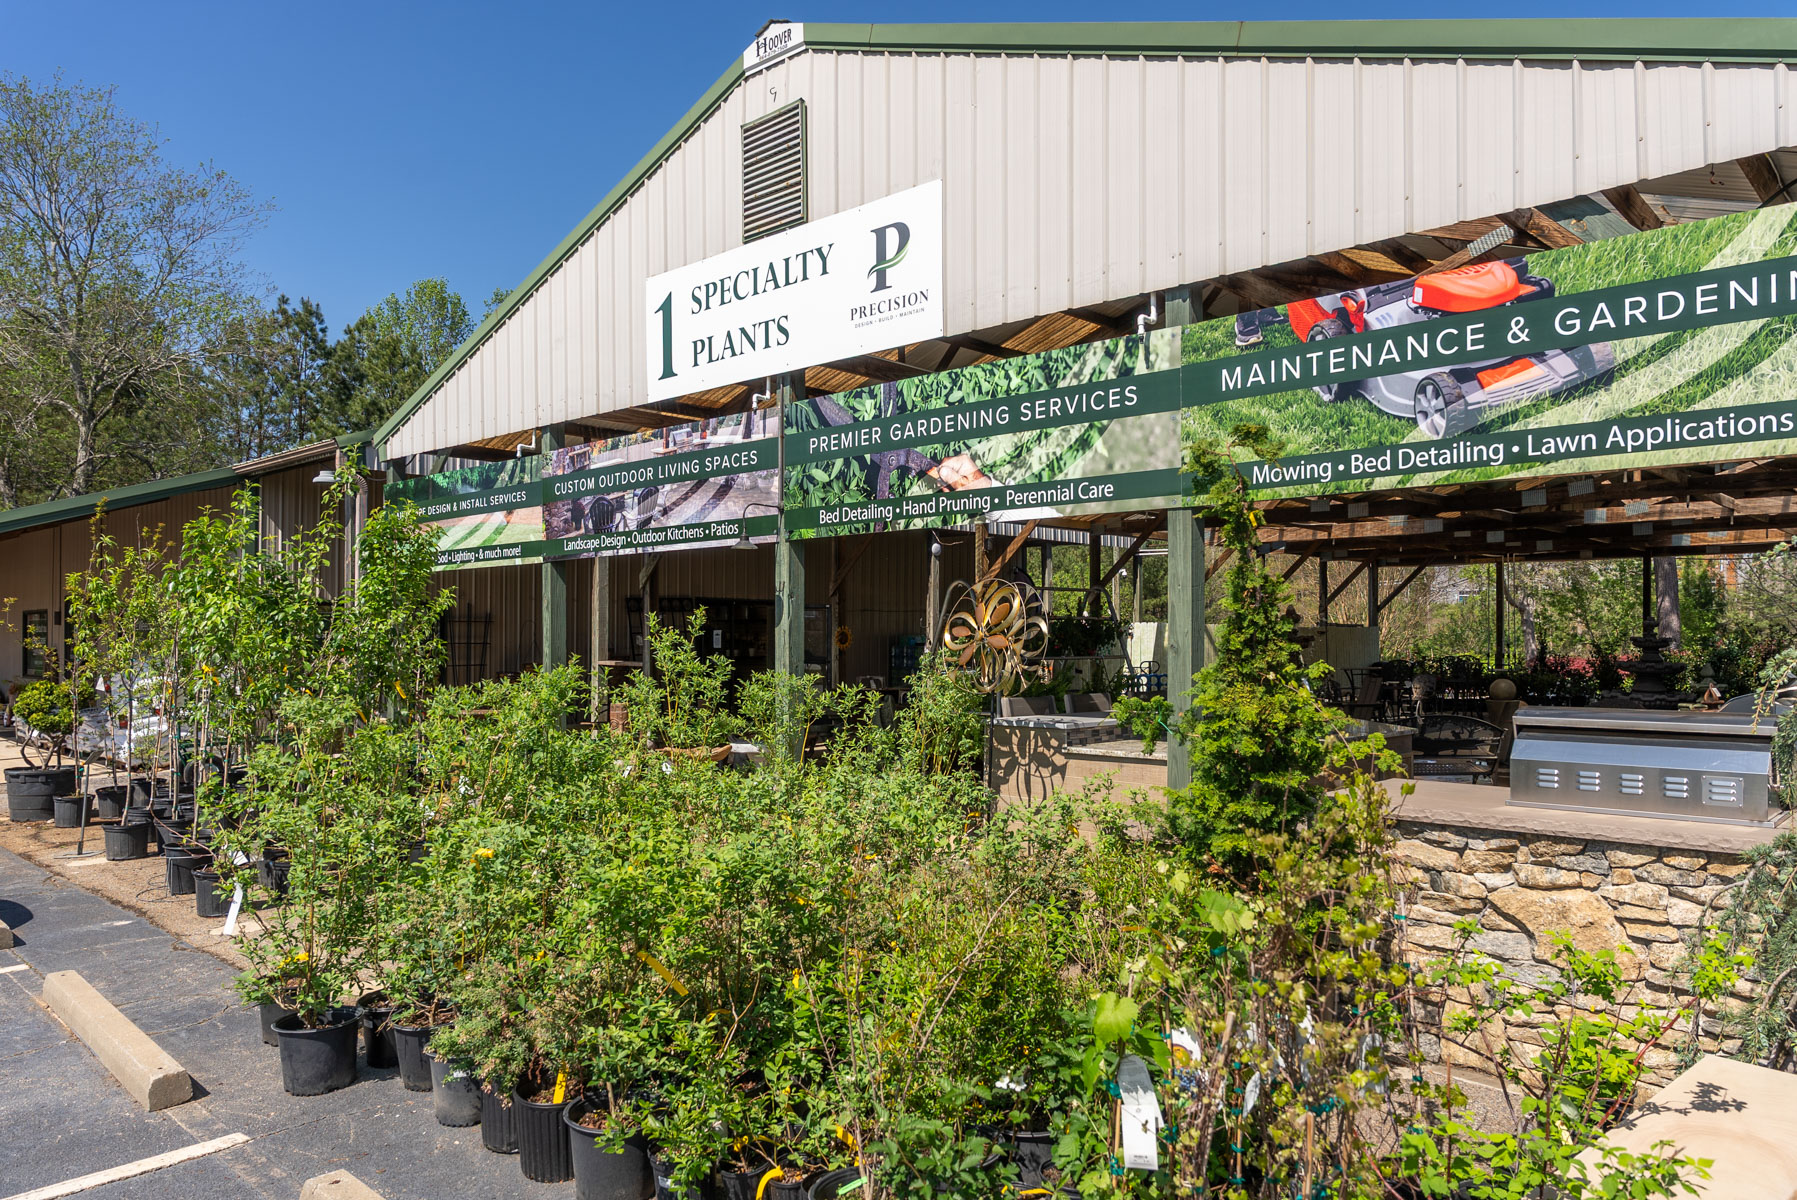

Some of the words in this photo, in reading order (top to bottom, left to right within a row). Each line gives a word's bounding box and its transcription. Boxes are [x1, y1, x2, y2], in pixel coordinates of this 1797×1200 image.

[756, 28, 792, 57] HOOVER
[691, 243, 834, 314] SPECIALTY
[850, 289, 929, 321] PRECISION
[855, 320, 873, 329] DESIGN
[878, 314, 894, 323] BUILD
[899, 307, 925, 318] MAINTAIN
[655, 291, 679, 380] 1
[691, 315, 789, 367] PLANTS
[1221, 321, 1485, 391] MAINTENANCE
[1507, 316, 1530, 344] &
[810, 427, 881, 454] PREMIER
[890, 405, 1010, 441] GARDENING
[1020, 386, 1138, 421] SERVICES
[1251, 459, 1332, 487] Mowing
[1352, 450, 1392, 474] Bed
[1399, 439, 1504, 470] Detailing
[1527, 432, 1597, 457] Lawn
[1605, 413, 1794, 452] Applications
[554, 478, 595, 496] CUSTOM
[599, 468, 654, 489] OUTDOOR
[658, 459, 700, 479] LIVING
[705, 450, 758, 472] SPACES
[428, 503, 451, 516] DESIGN
[453, 502, 458, 512] &
[460, 497, 488, 511] INSTALL
[490, 490, 527, 506] SERVICES
[819, 507, 840, 524] Bed
[843, 503, 893, 522] Detailing
[903, 498, 936, 515] Hand
[940, 495, 991, 515] Pruning
[1006, 483, 1074, 506] Perennial
[1078, 482, 1114, 500] Care
[451, 550, 475, 564] Lighting
[479, 548, 484, 560] &
[484, 547, 502, 559] much
[503, 544, 522, 558] more!
[564, 538, 600, 554] Landscape
[600, 534, 627, 550] Design
[632, 530, 666, 546] Outdoor
[667, 526, 704, 542] Kitchens
[711, 522, 739, 537] Patios
